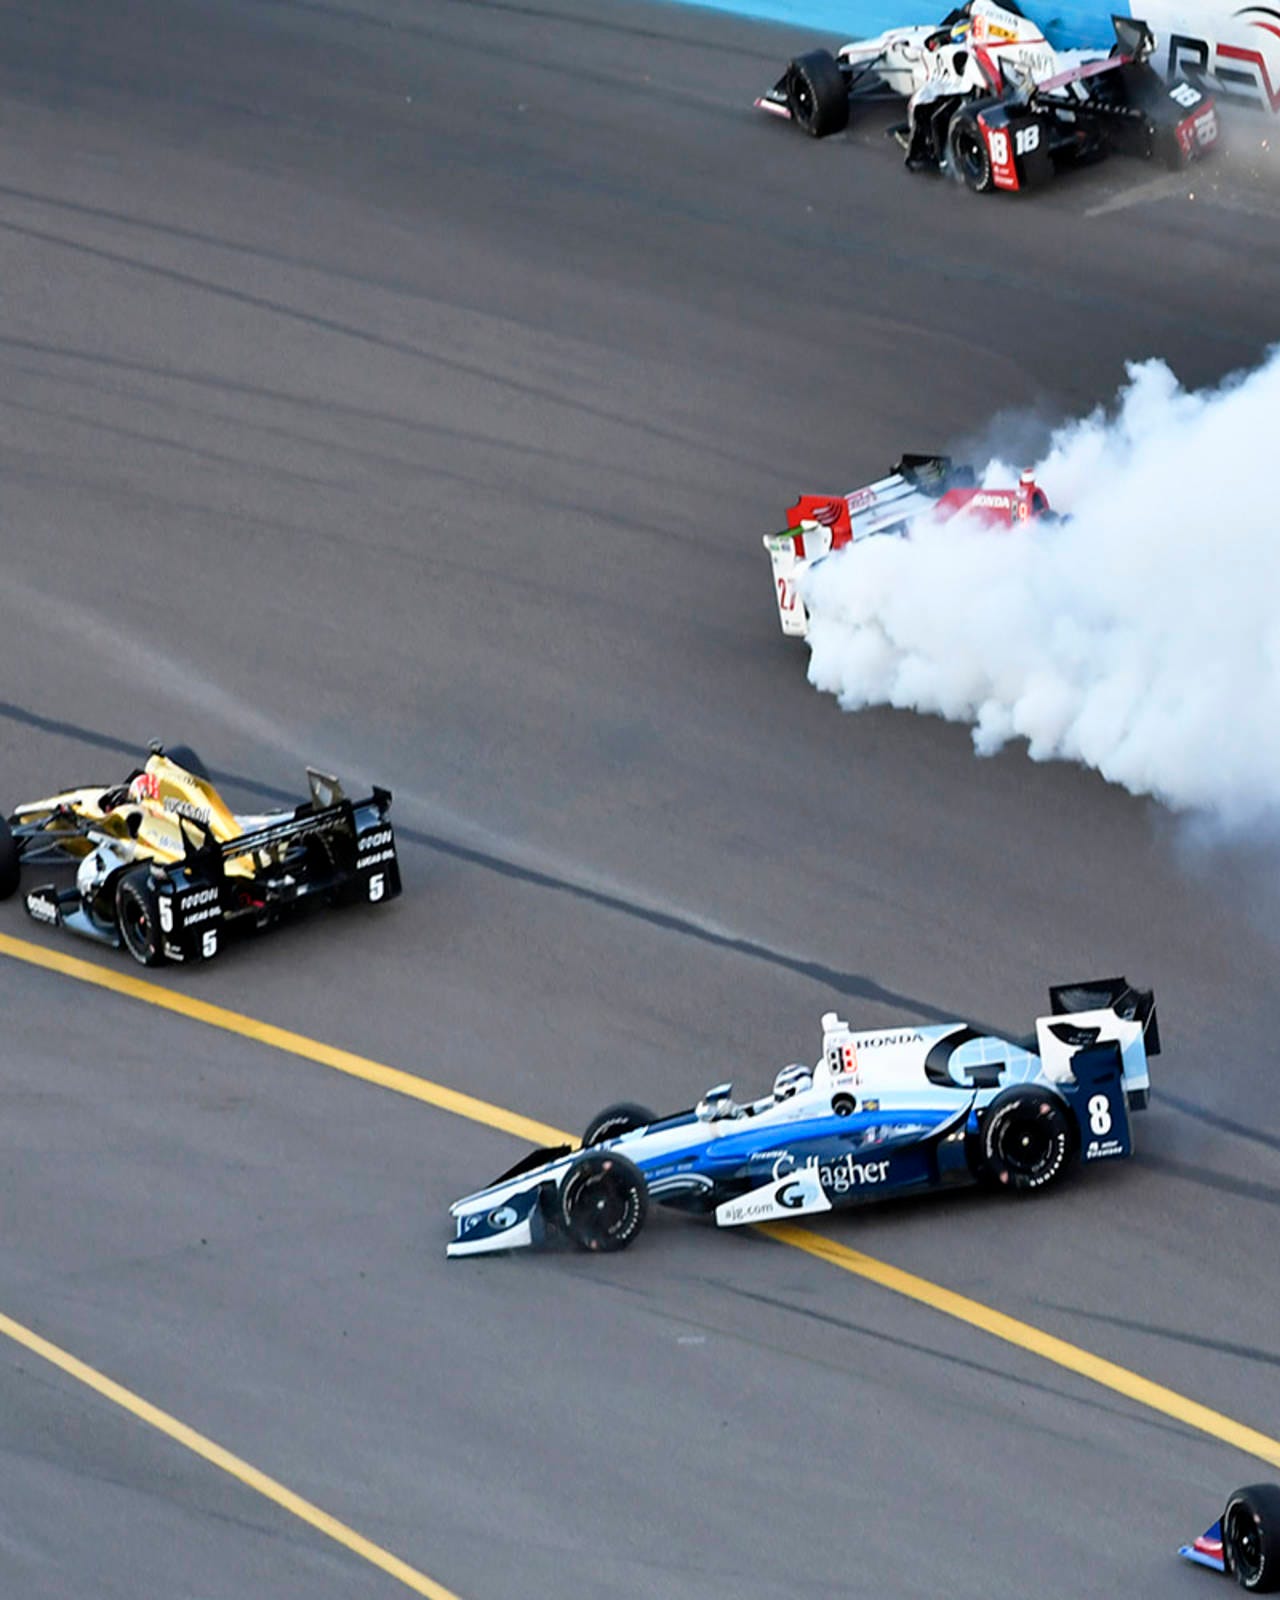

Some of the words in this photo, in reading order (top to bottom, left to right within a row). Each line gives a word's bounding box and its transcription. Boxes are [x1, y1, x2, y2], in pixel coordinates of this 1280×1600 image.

[1169, 82, 1202, 107] 18
[987, 130, 1008, 166] 18
[1015, 124, 1040, 156] 18
[369, 872, 384, 902] 5
[158, 895, 173, 933] 5
[202, 928, 217, 958] 5
[856, 1033, 924, 1050] HONDA
[1088, 1095, 1111, 1135] 8
[774, 1181, 805, 1209] G
